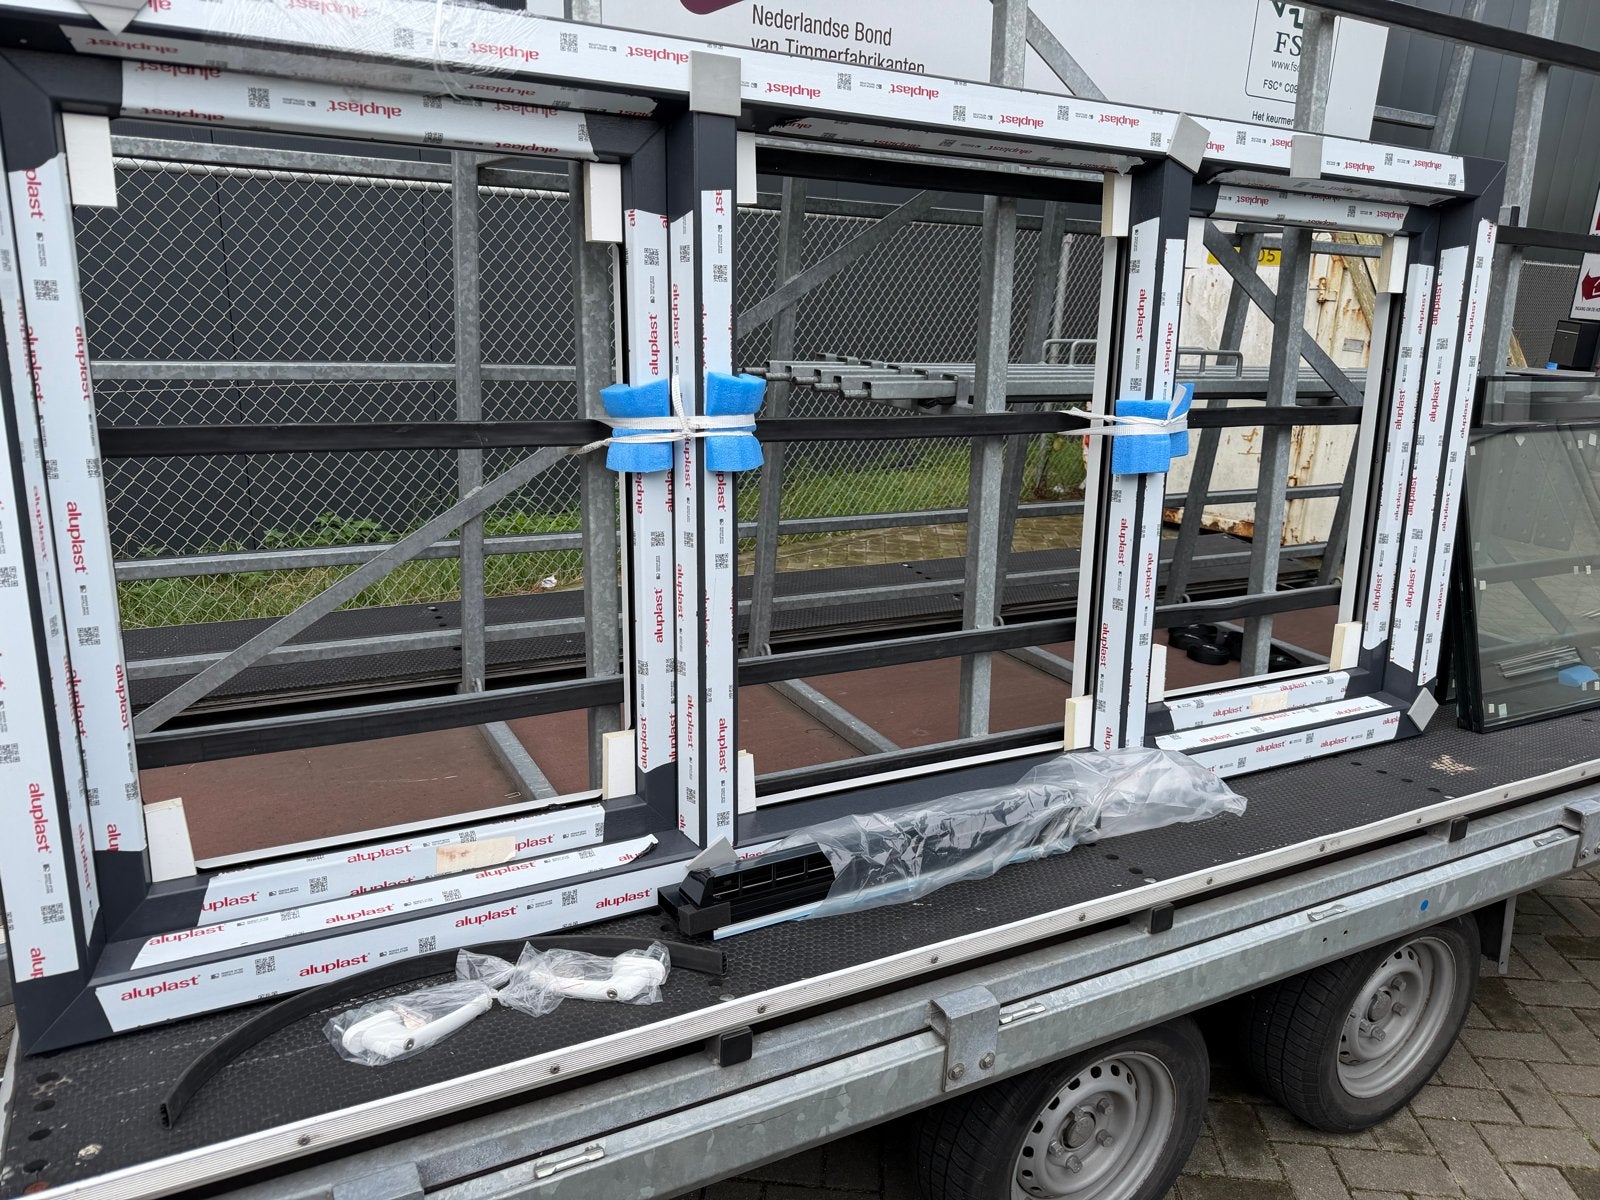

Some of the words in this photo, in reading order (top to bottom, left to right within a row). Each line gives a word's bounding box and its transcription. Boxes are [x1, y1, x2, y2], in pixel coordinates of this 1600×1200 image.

[752, 4, 849, 40] Nederlandse
[855, 22, 892, 46] Bond
[471, 41, 540, 62] aluplast
[628, 46, 689, 64] aluplast
[751, 37, 779, 51] van
[1273, 31, 1302, 56] FS
[468, 82, 536, 97] aluplast
[767, 82, 821, 99] aluplast
[891, 84, 939, 100] aluplast
[329, 99, 402, 119] aluplast
[1000, 114, 1044, 129] aluplast
[1100, 113, 1140, 128] aluplast
[1251, 111, 1265, 121] Het
[1266, 113, 1294, 125] keurmer
[1206, 141, 1225, 153] alup
[1270, 138, 1292, 149] plast
[1344, 161, 1375, 173] aluplast
[1414, 159, 1442, 171] aluplast
[25, 168, 44, 219] plast
[1236, 195, 1269, 207] aluplast
[671, 284, 680, 346] aluplast
[1136, 288, 1147, 340] aluplast
[648, 313, 660, 376] aluplast
[1163, 322, 1174, 373] aluplast
[75, 326, 90, 401] aluplast
[1395, 389, 1406, 430] aluplast
[1428, 381, 1440, 422] aluplast
[683, 436, 691, 488] luplast
[635, 472, 645, 514] alupla
[716, 471, 727, 512] plast
[66, 500, 87, 574] aluplast
[1118, 518, 1128, 565] aluplast
[1144, 553, 1154, 599] aluplast
[1405, 568, 1416, 608] aluplast
[676, 563, 684, 618] aluplast
[1372, 573, 1383, 611] aluplast
[654, 588, 664, 643] aluplast
[1100, 622, 1110, 667] aluplast
[115, 664, 130, 731] aluplast
[686, 694, 694, 748] aluplast
[1213, 705, 1242, 717] aluplast
[640, 716, 649, 769] aluplast
[717, 718, 728, 772] aluplast
[1104, 726, 1113, 751] alup
[1255, 741, 1285, 753] aluplast
[1321, 736, 1348, 748] aluplast
[29, 783, 50, 853] aluplast
[347, 844, 411, 864] aluplast
[515, 834, 553, 853] plast
[475, 861, 536, 879] aluplast
[201, 892, 257, 912] uplast
[596, 889, 651, 909] aluplast
[325, 905, 393, 925] aluplast
[455, 906, 517, 928] aluplast
[149, 925, 225, 946] aluplast
[299, 953, 369, 977] aluplast
[120, 976, 198, 1002] aluplast
